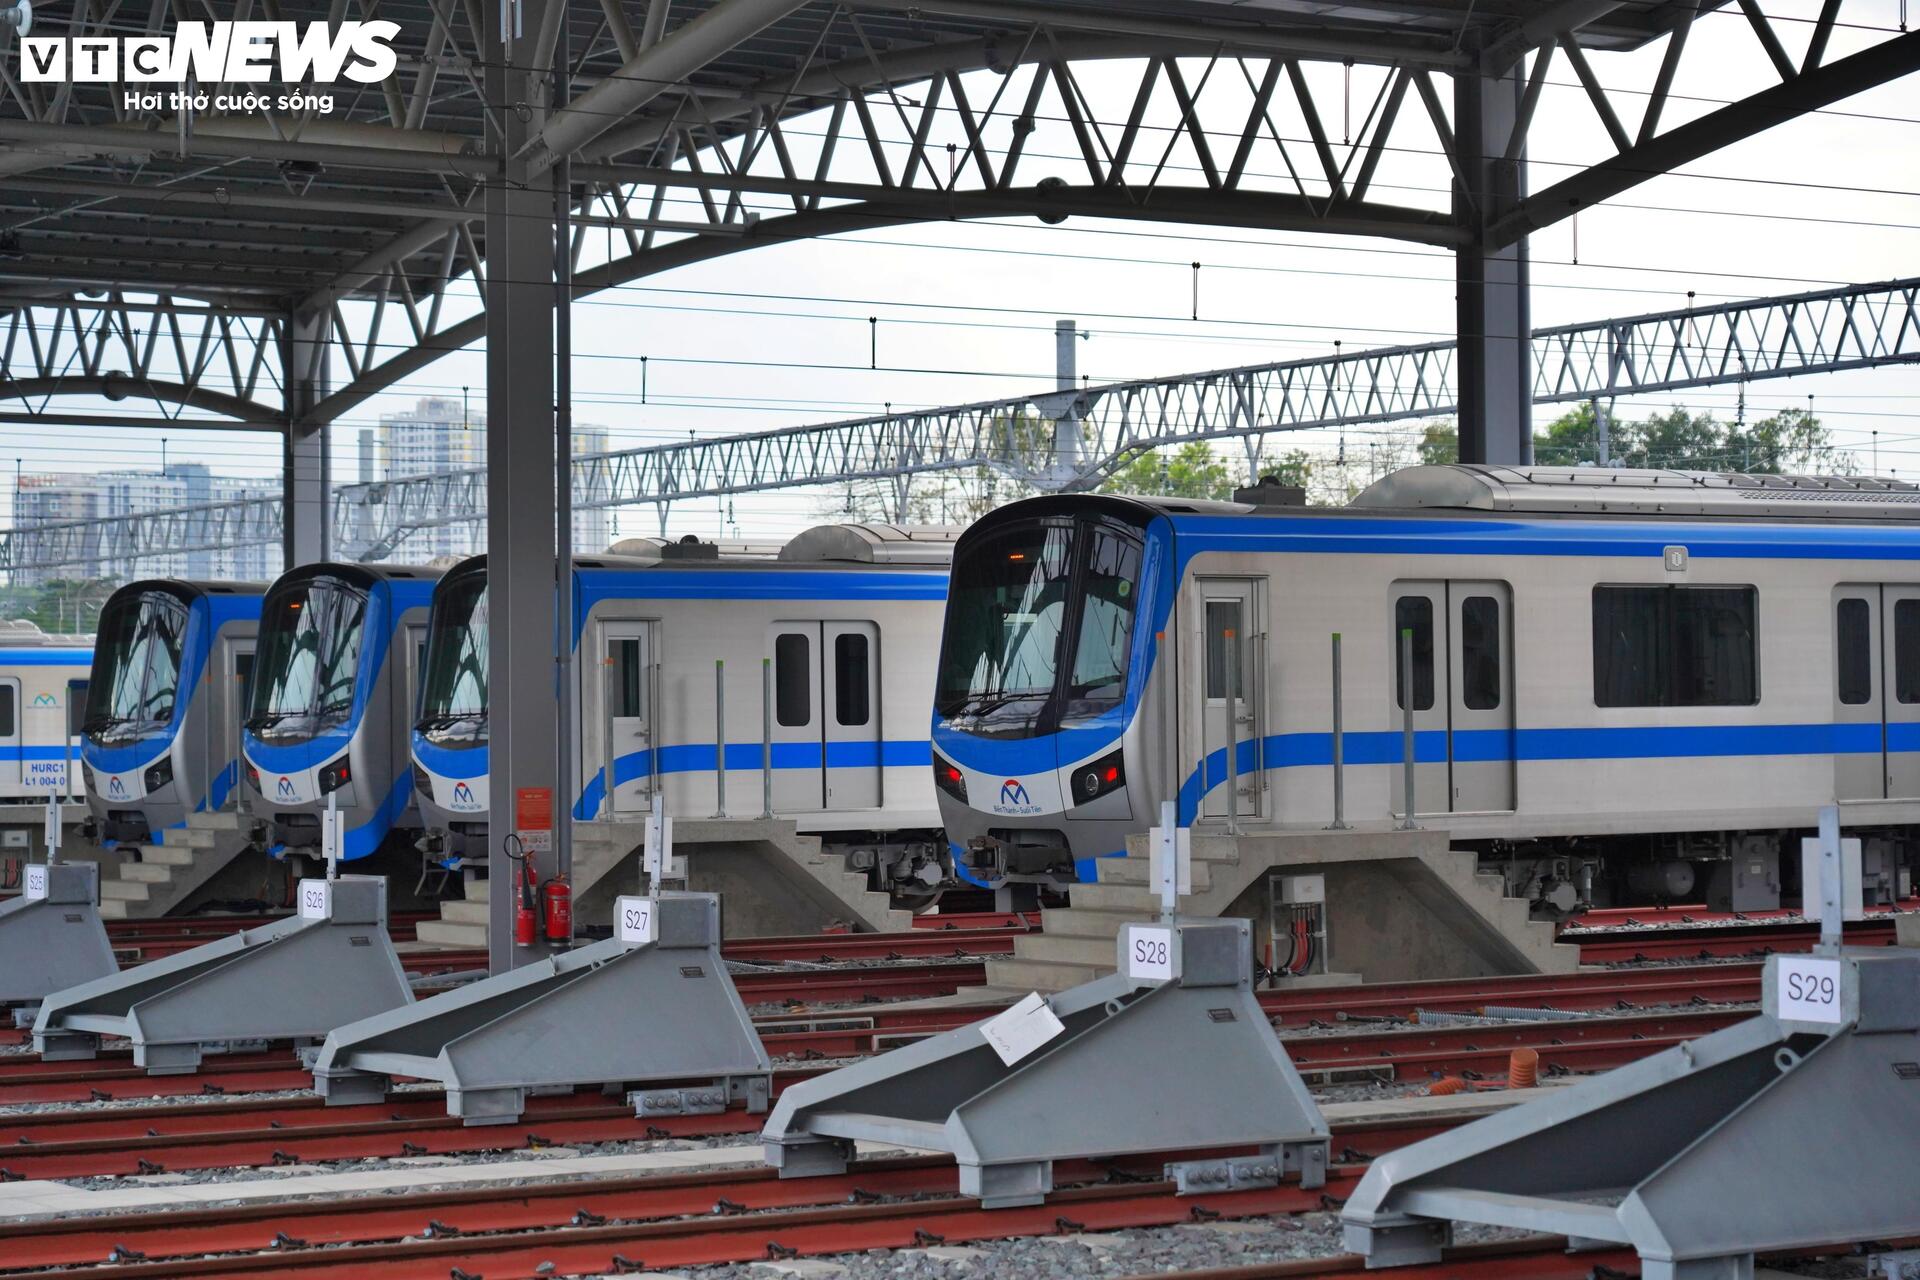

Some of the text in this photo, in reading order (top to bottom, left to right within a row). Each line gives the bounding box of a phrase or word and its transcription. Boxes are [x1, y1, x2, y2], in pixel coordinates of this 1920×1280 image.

[31, 763, 64, 773] HURC1
[29, 874, 43, 890] S25
[306, 890, 323, 909] S26
[625, 909, 648, 931] S27
[1135, 939, 1167, 965] S28
[1788, 972, 1835, 1004] S29
